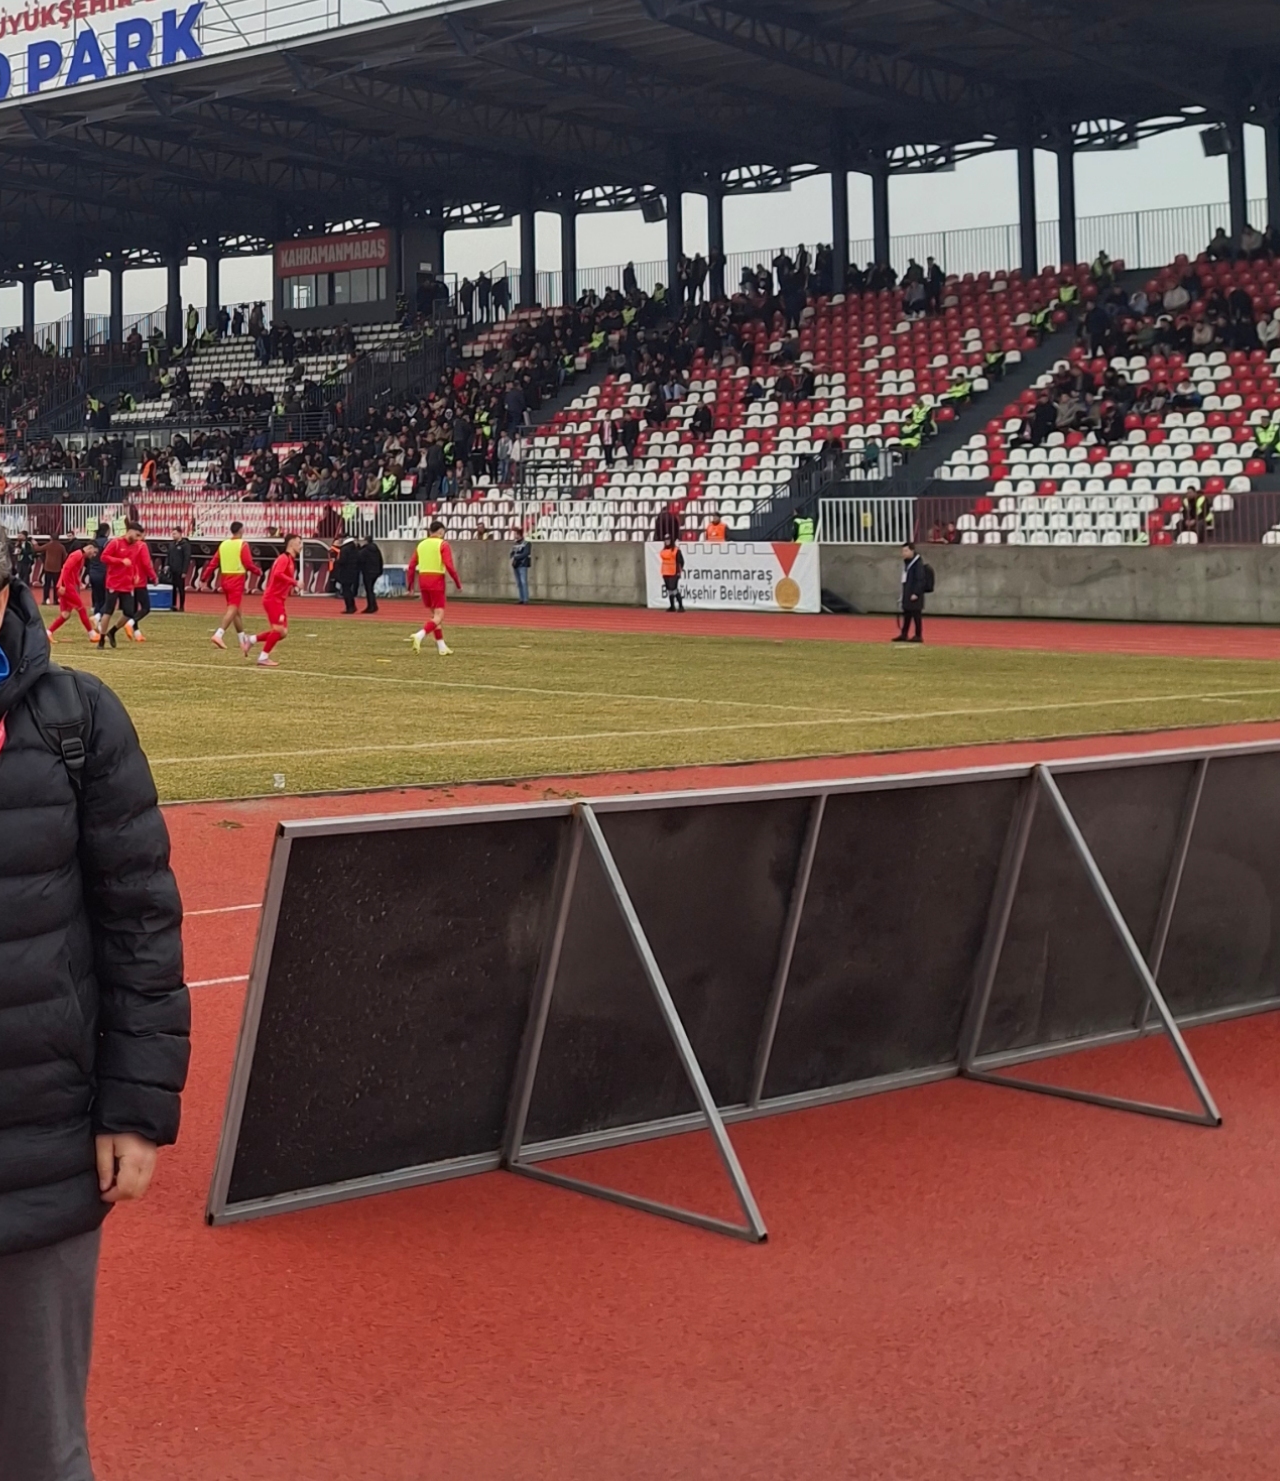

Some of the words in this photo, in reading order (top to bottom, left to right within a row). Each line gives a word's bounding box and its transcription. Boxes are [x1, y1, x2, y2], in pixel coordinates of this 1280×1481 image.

[27, 2, 206, 95] PARK
[280, 238, 386, 269] KAHRAMANMARAŞ
[681, 567, 773, 585] ramanmaraş
[661, 584, 717, 604] Bükşehir
[720, 584, 773, 605] Belediyesi
